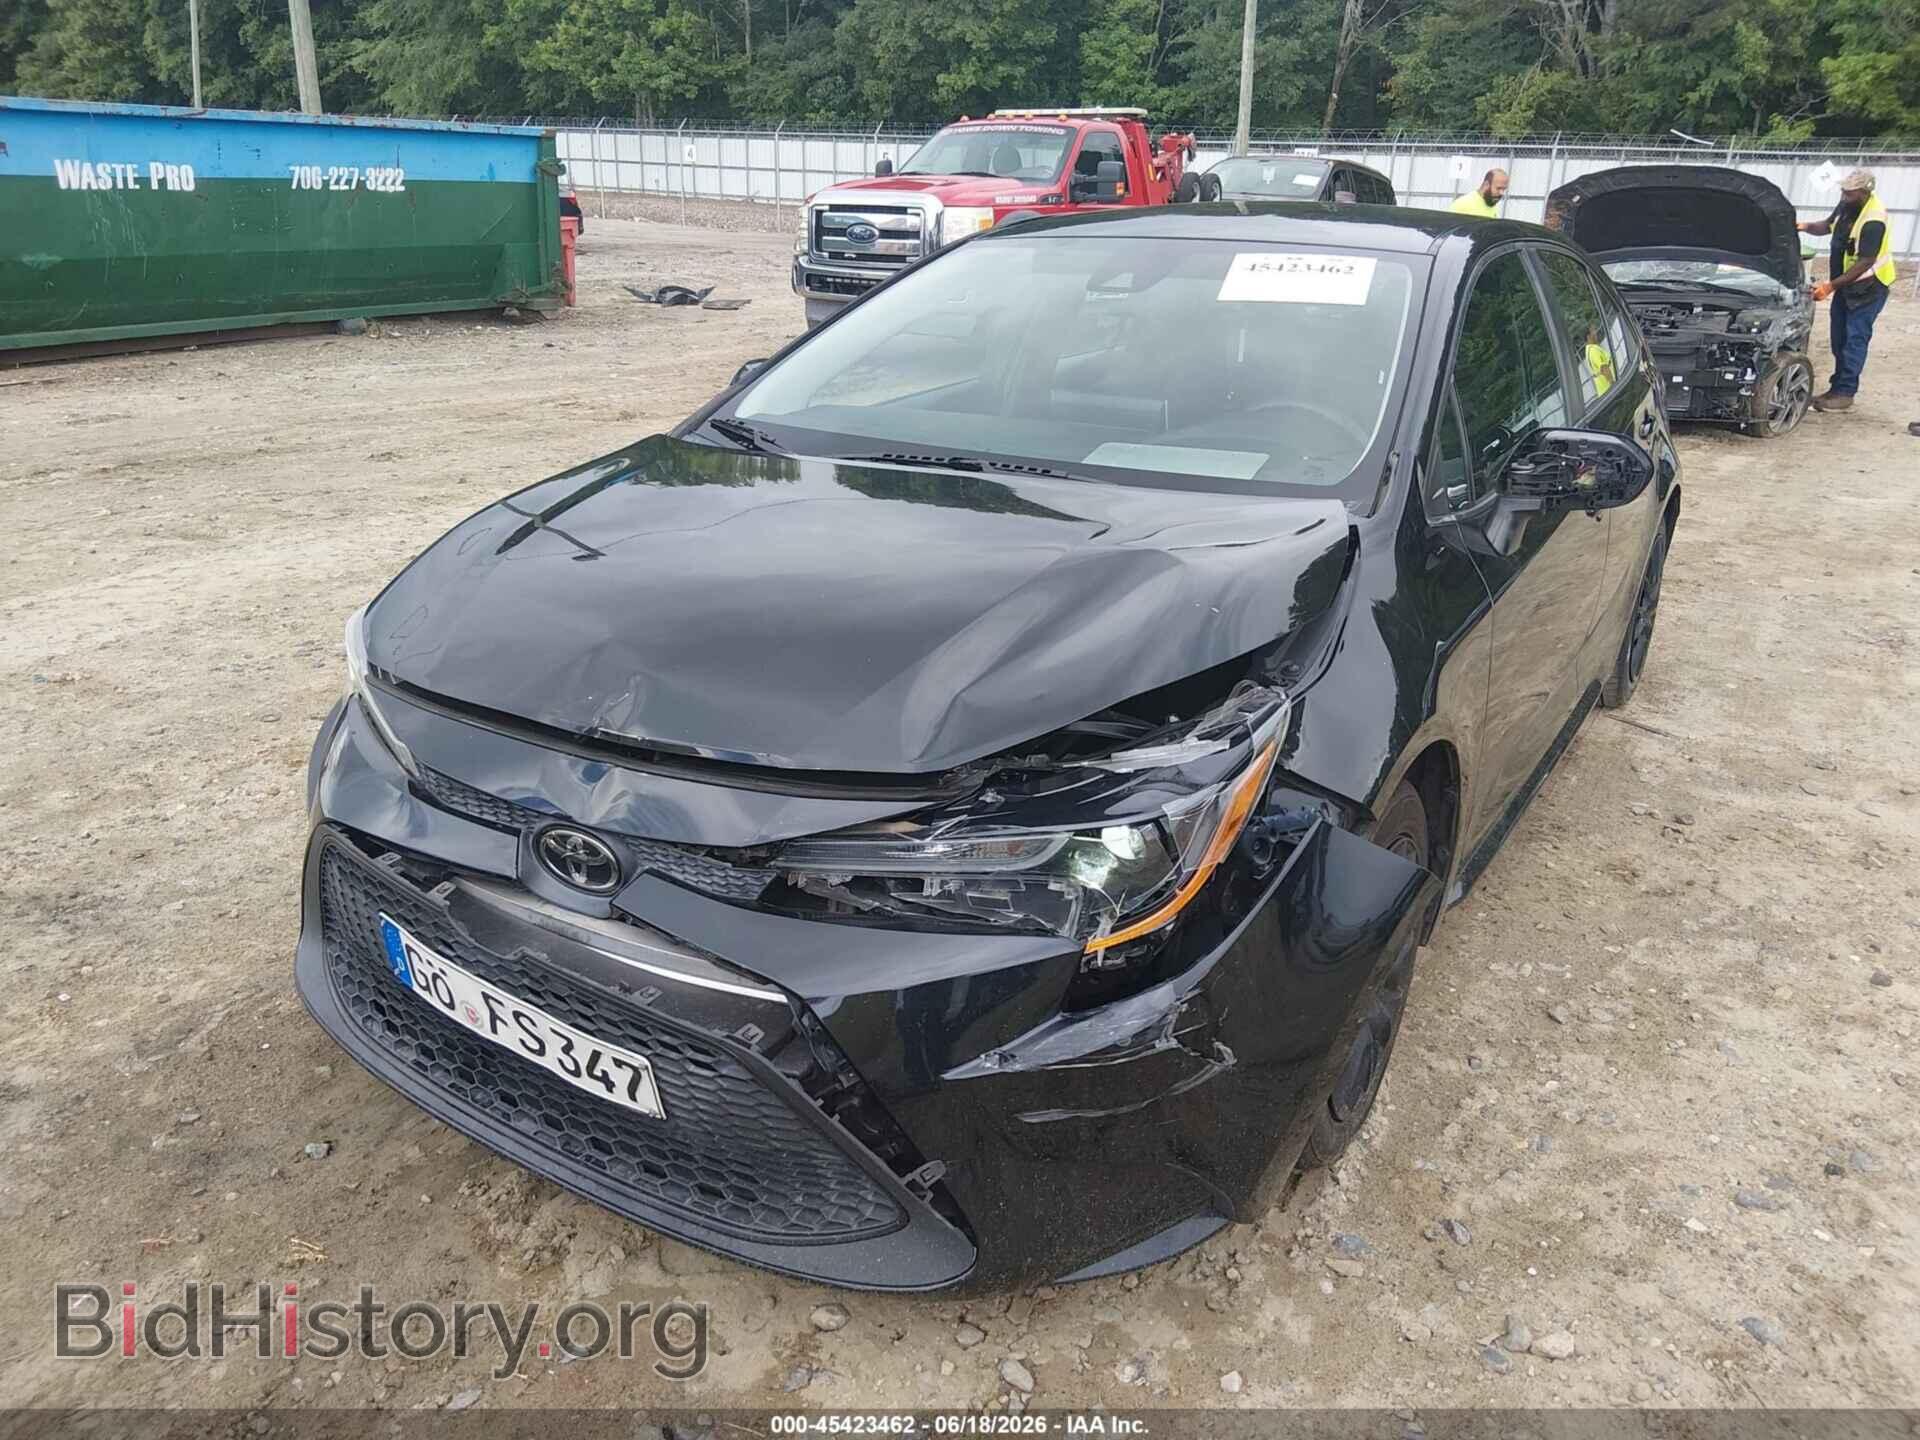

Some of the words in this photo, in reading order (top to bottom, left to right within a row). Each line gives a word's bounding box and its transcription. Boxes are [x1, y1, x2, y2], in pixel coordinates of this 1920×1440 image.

[54, 159, 140, 190] WASTE
[150, 160, 196, 192] PRO
[289, 165, 405, 192] 706-227-3222
[1244, 263, 1354, 275] 45423462
